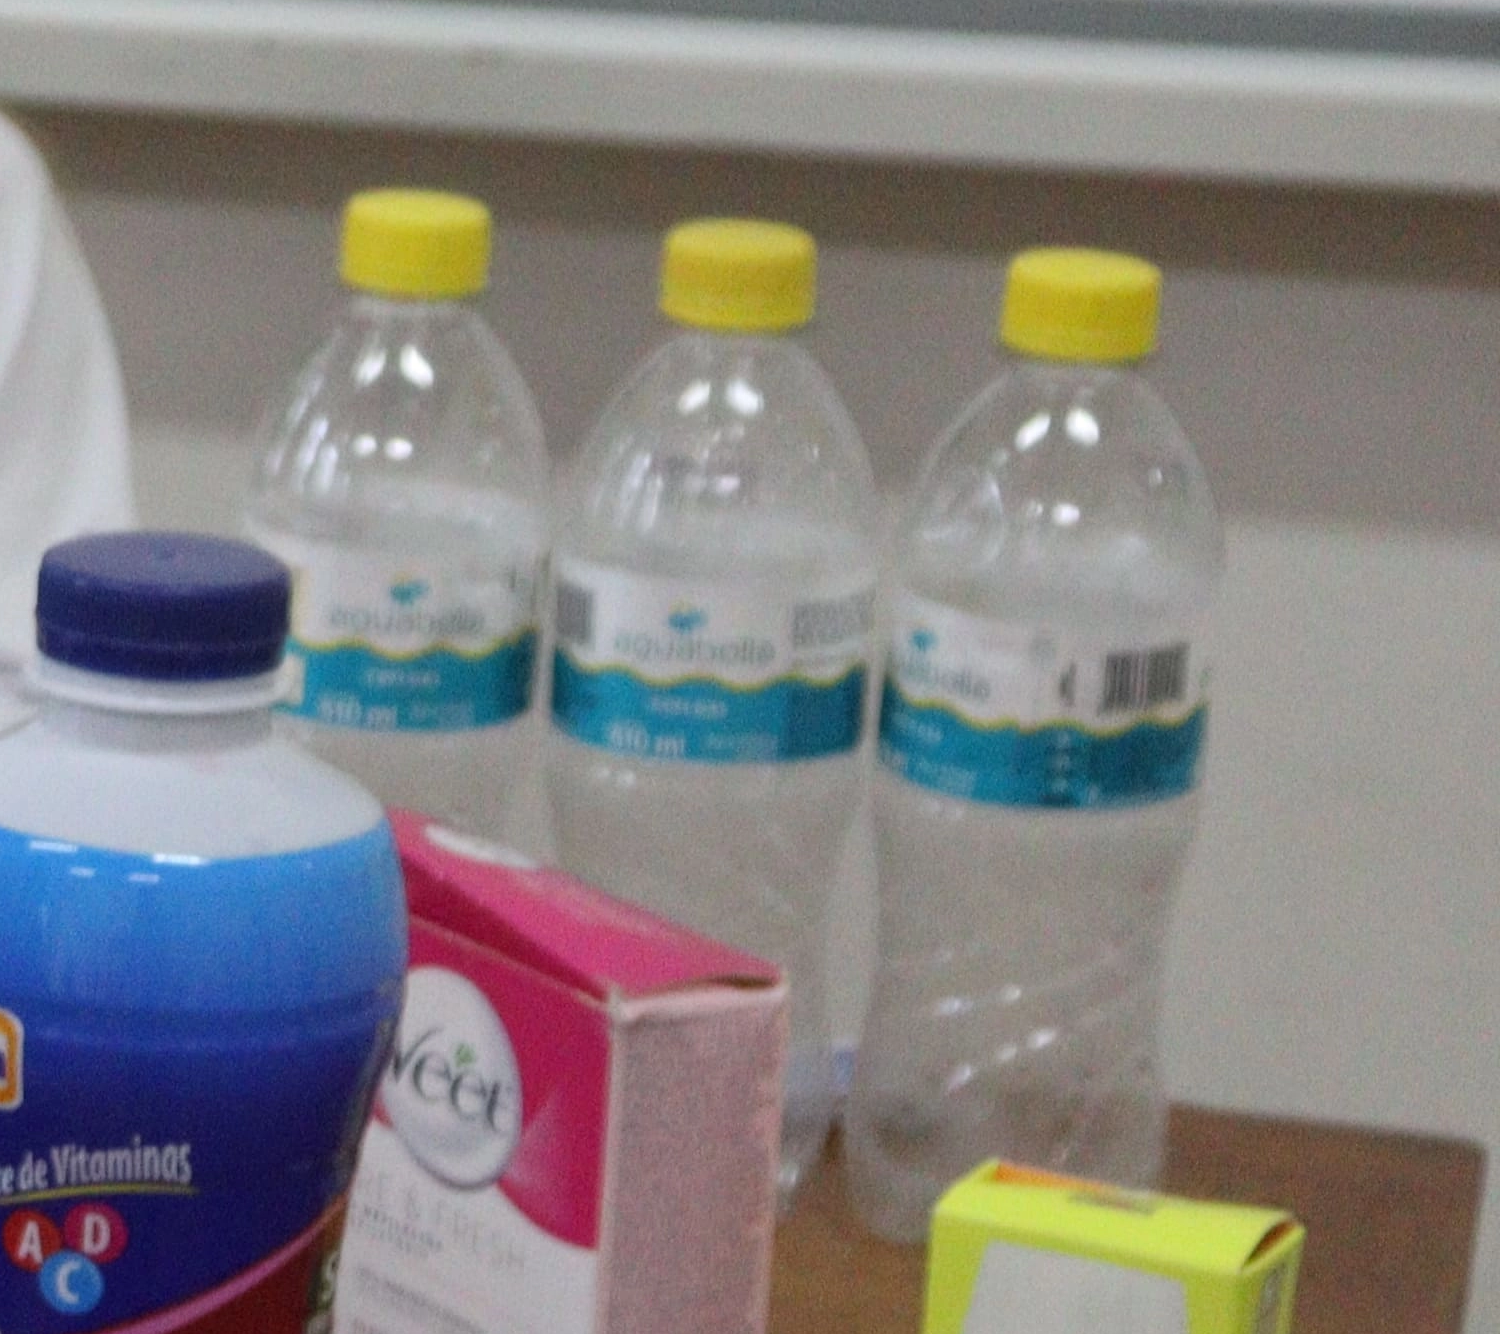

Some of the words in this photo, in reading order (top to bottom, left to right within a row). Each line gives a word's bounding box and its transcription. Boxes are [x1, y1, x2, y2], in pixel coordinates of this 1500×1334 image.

[390, 1025, 516, 1134] Veet
[18, 1151, 49, 1191] de
[49, 1134, 194, 1187] Vitaminas
[17, 1220, 45, 1266] A
[82, 1213, 112, 1257] D
[56, 1259, 81, 1305] C
